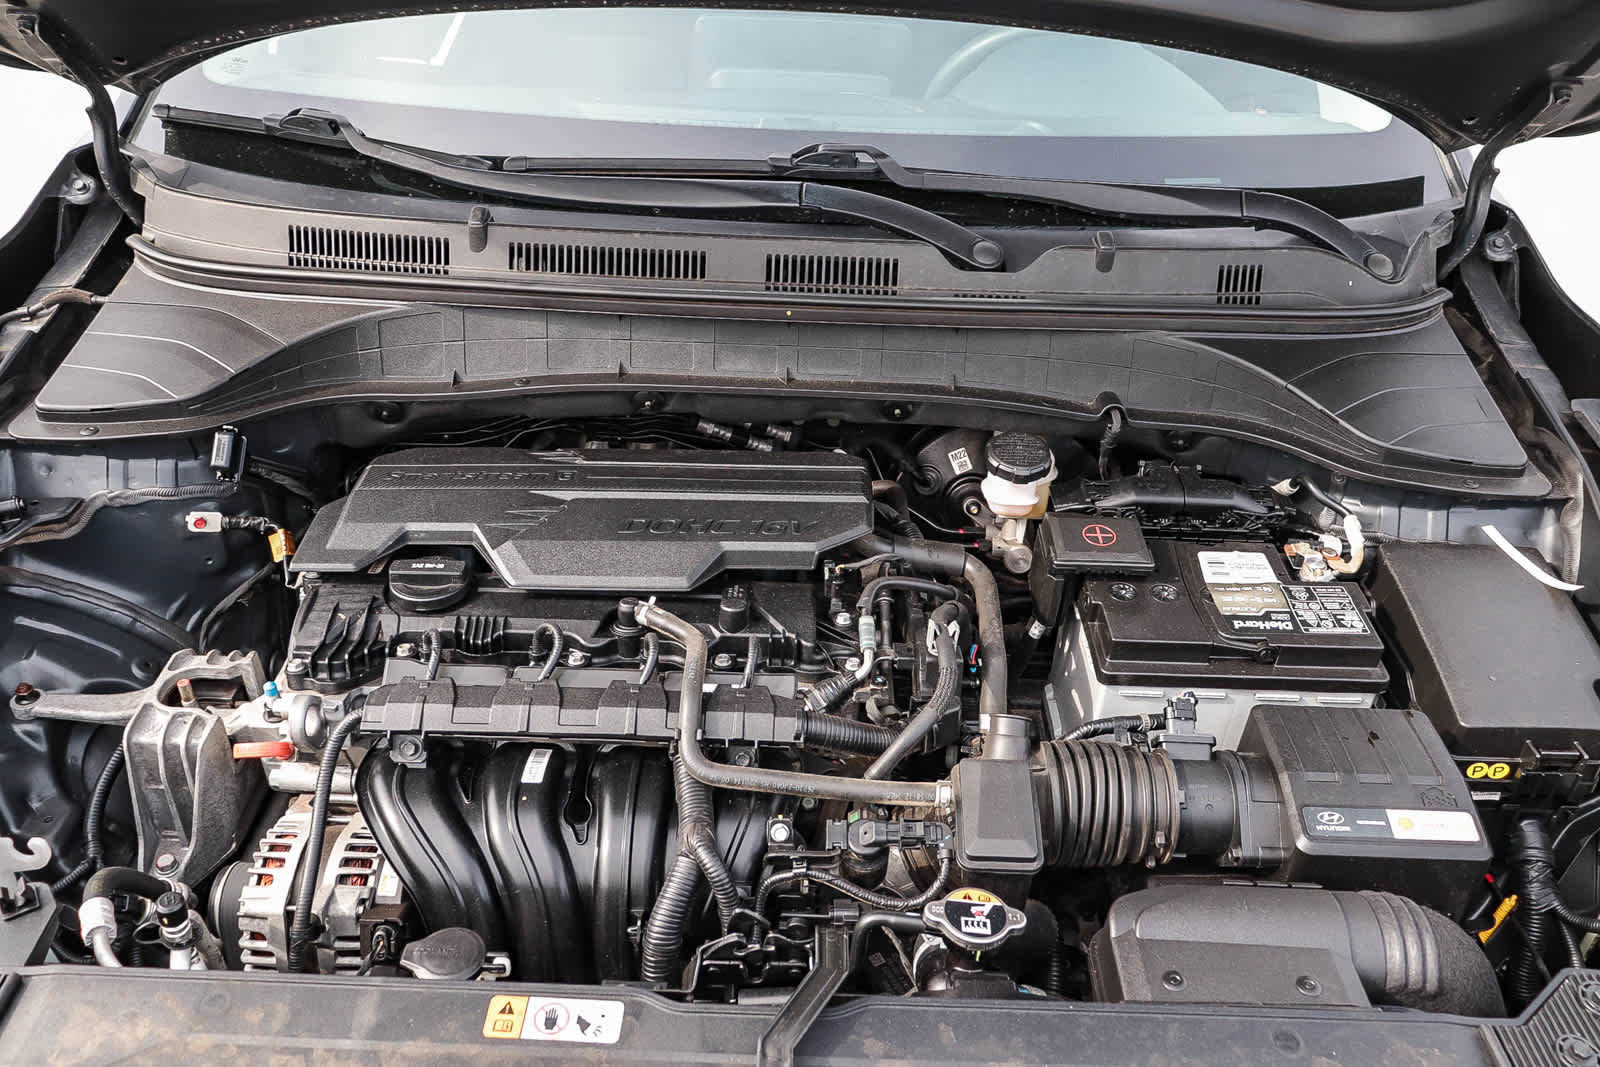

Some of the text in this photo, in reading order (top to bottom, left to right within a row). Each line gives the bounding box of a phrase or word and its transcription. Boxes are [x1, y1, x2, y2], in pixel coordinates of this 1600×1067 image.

[951, 449, 967, 462] M22
[616, 519, 824, 535] DOHC 16V
[1233, 619, 1294, 631] DieHard
[1472, 765, 1505, 777] P P
